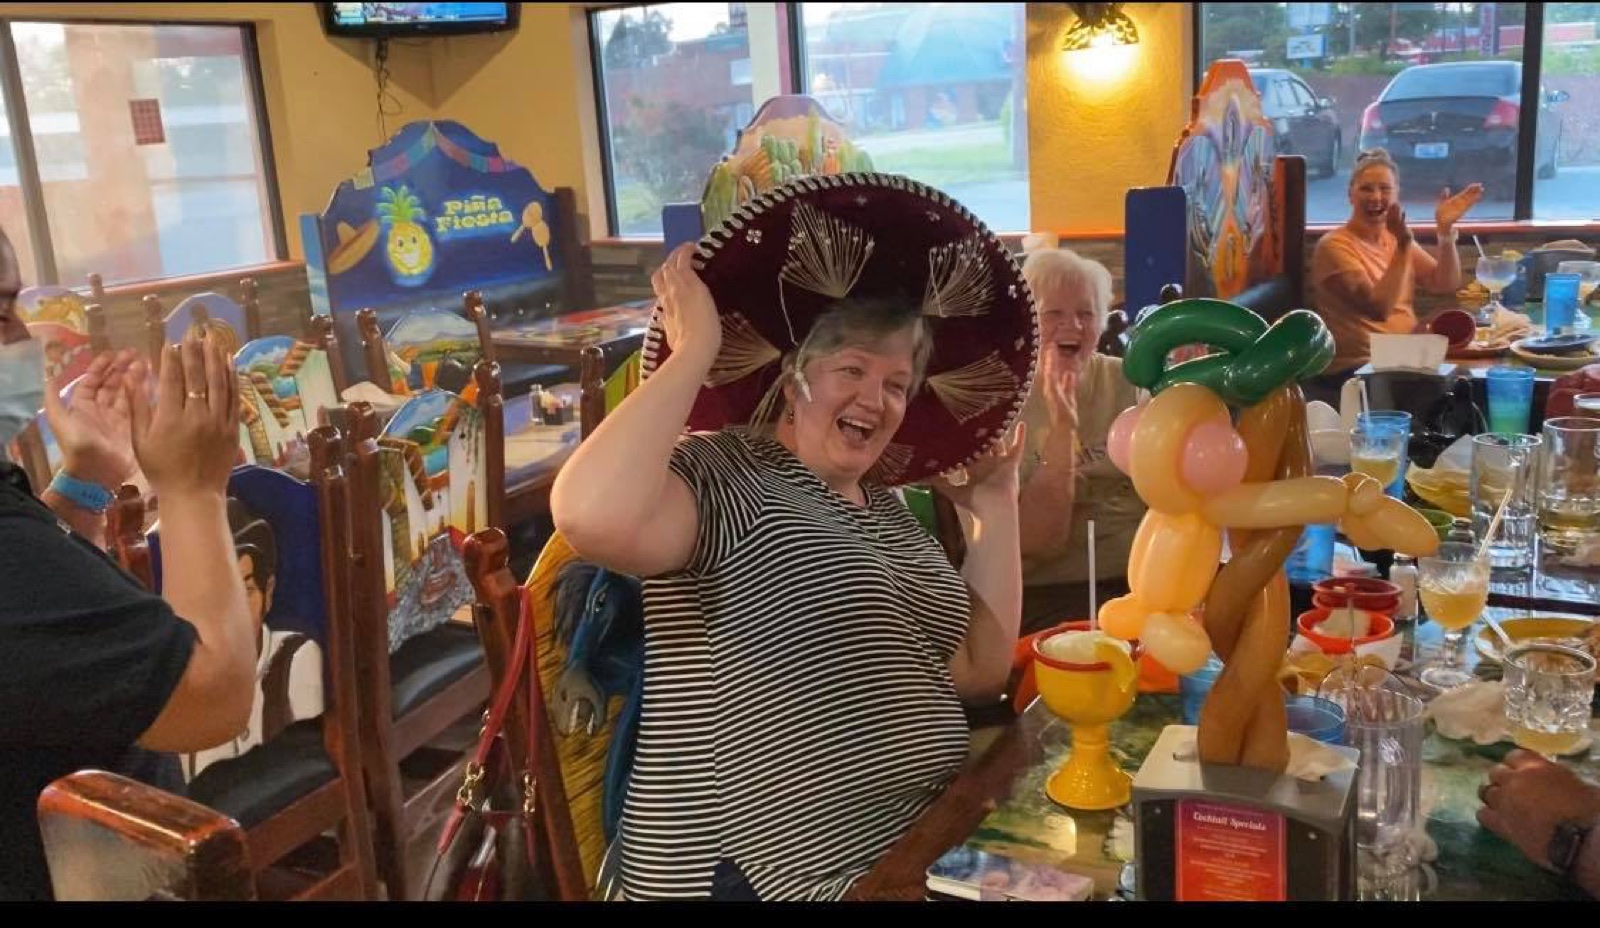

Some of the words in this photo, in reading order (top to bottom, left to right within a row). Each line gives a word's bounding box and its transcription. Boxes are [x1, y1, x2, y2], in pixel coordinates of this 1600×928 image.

[444, 195, 502, 214] Piña
[435, 211, 513, 232] Fiesta
[1193, 811, 1228, 825] Cocktail
[1229, 818, 1267, 830] Specials
